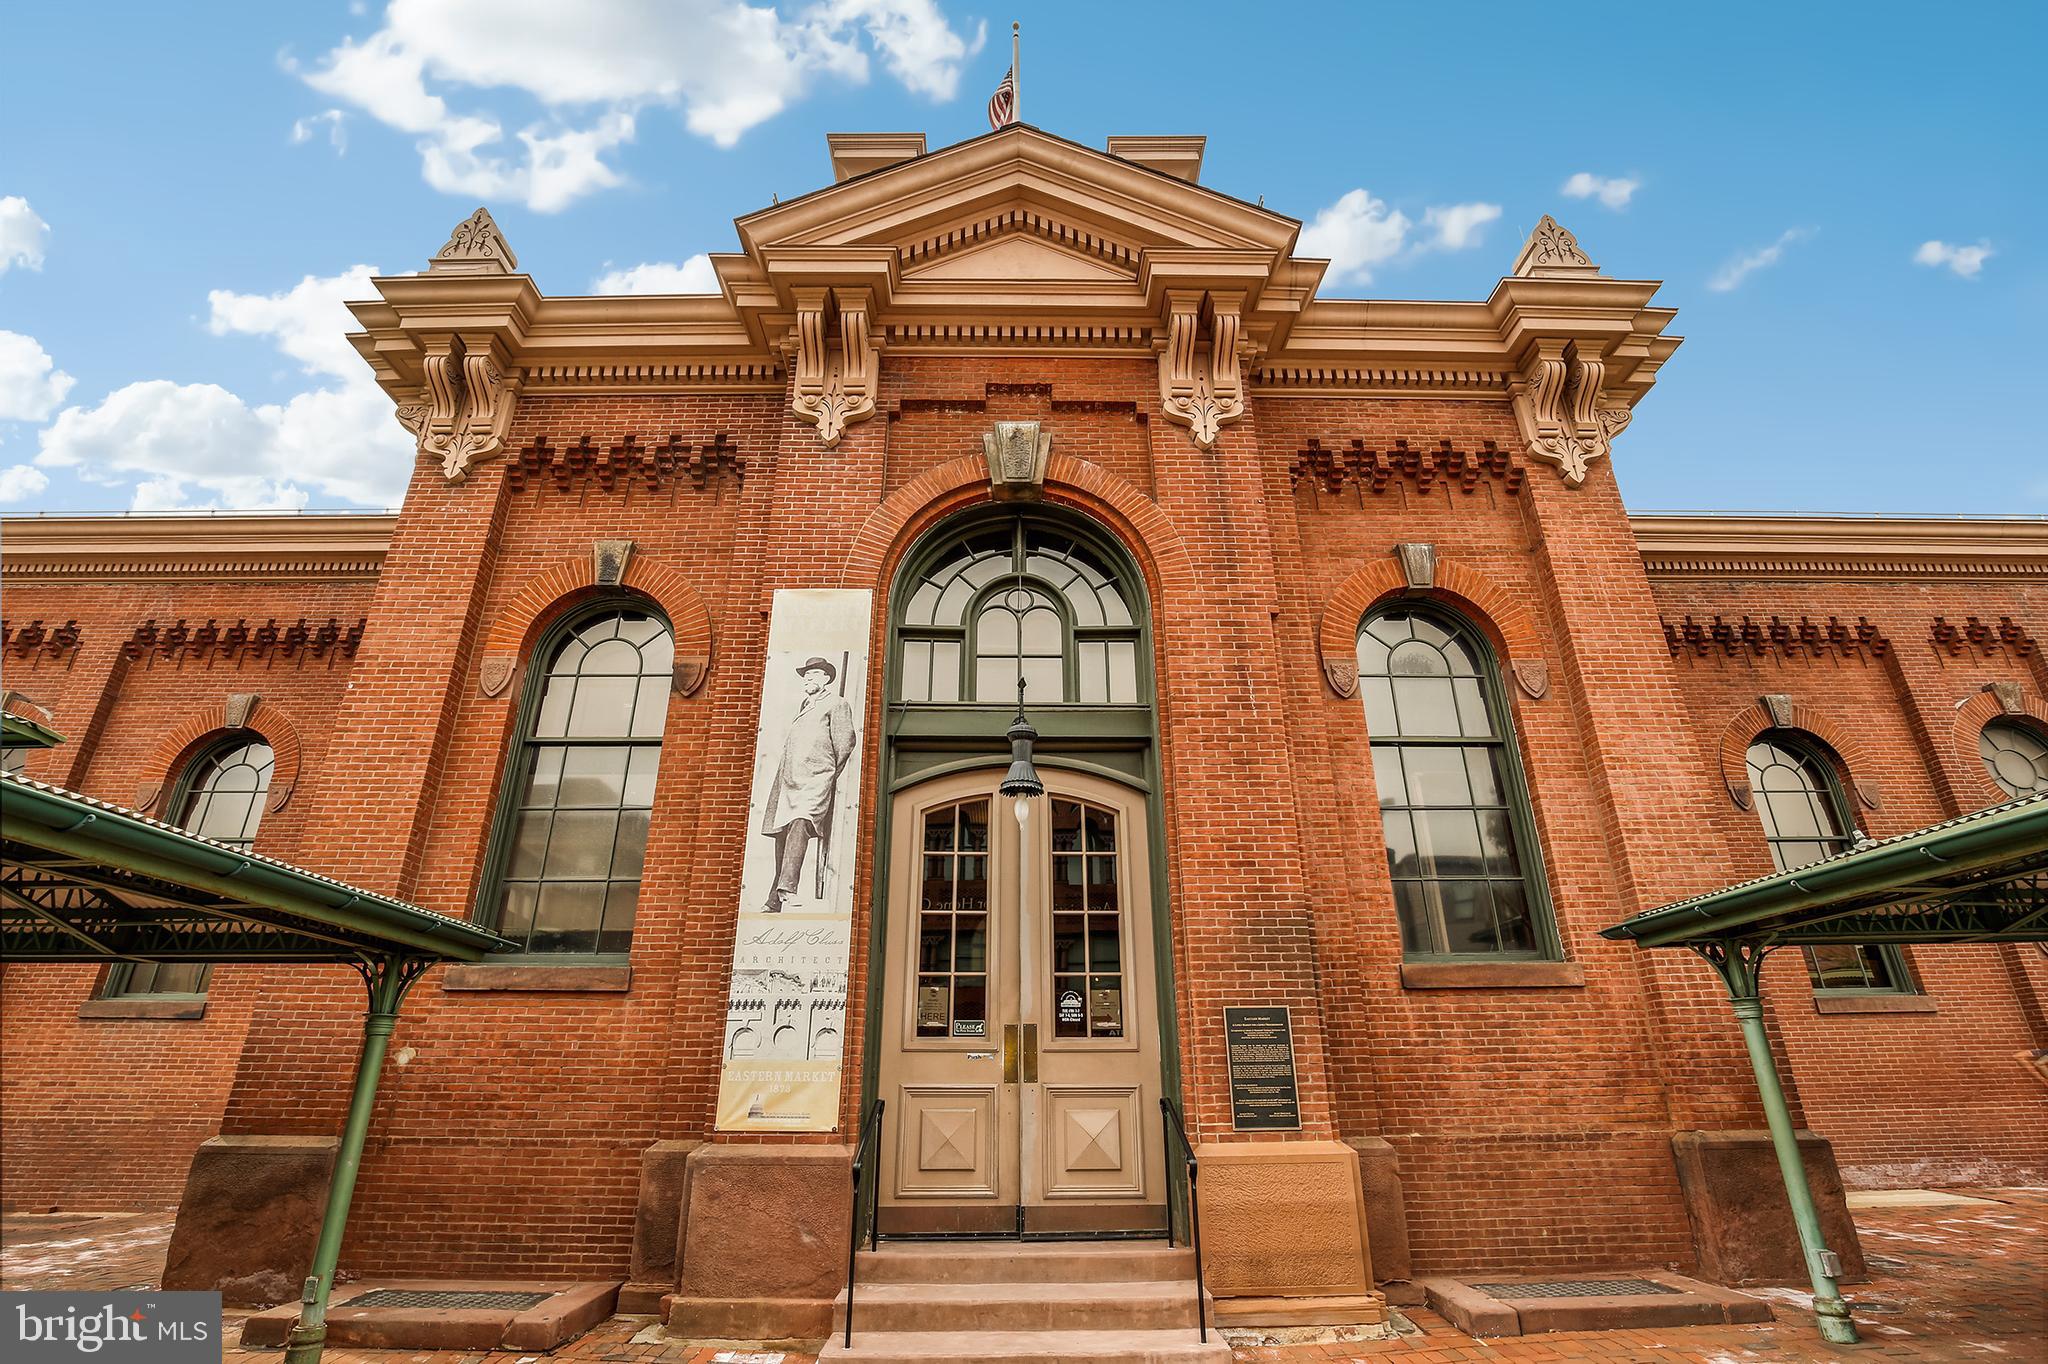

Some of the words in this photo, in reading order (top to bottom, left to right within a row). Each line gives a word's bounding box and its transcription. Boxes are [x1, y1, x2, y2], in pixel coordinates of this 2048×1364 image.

[743, 927, 805, 953] Adolf
[739, 955, 843, 964] ARCHITECT
[920, 1012, 945, 1021] HERE
[727, 1071, 781, 1081] EASTERN
[785, 1071, 836, 1082] MARKET
